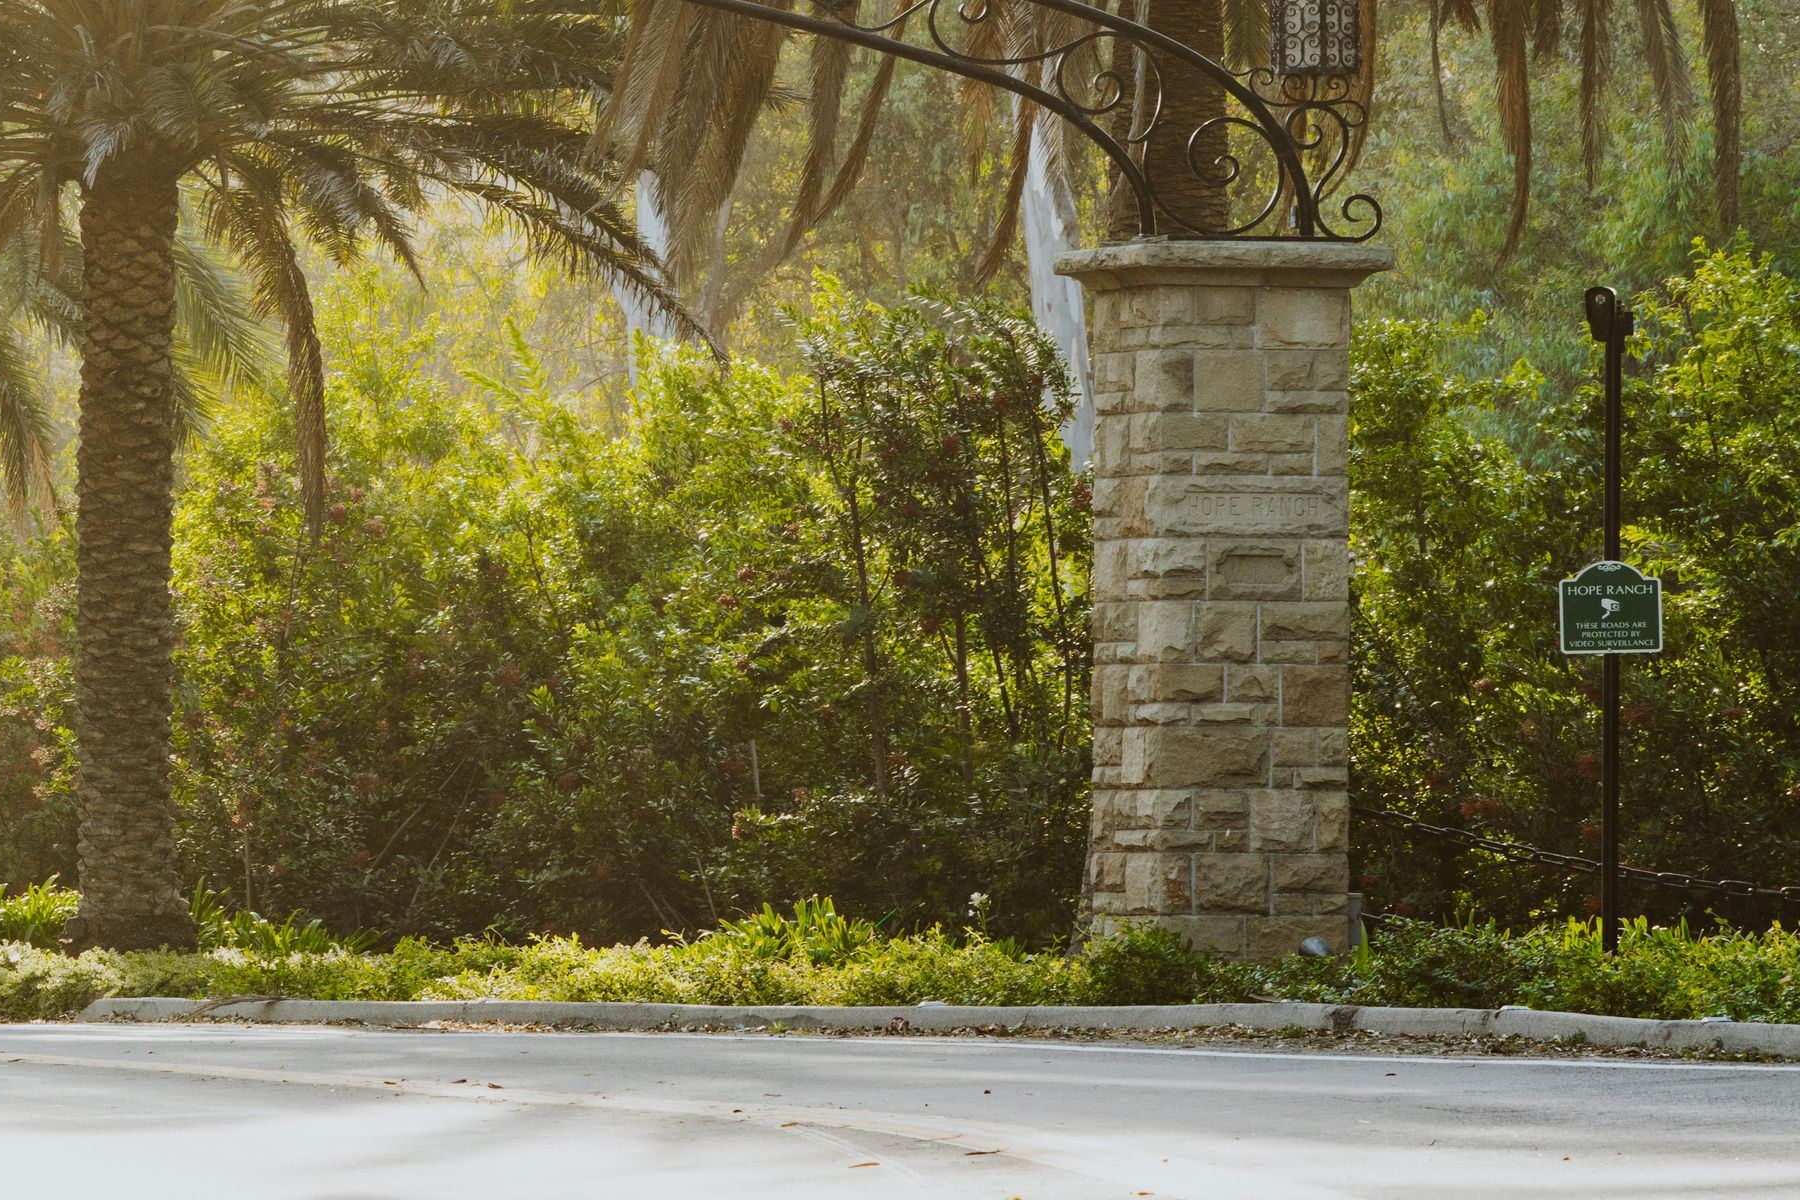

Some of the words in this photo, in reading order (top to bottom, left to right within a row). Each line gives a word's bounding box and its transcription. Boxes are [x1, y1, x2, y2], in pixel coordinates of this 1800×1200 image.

[1187, 496, 1241, 518] HOPE
[1252, 496, 1319, 518] RANCH
[1567, 585, 1603, 596] HOPE
[1606, 584, 1653, 595] RANCH
[1569, 640, 1595, 648] VIDEO
[1597, 639, 1655, 647] SURVEILLANCE
